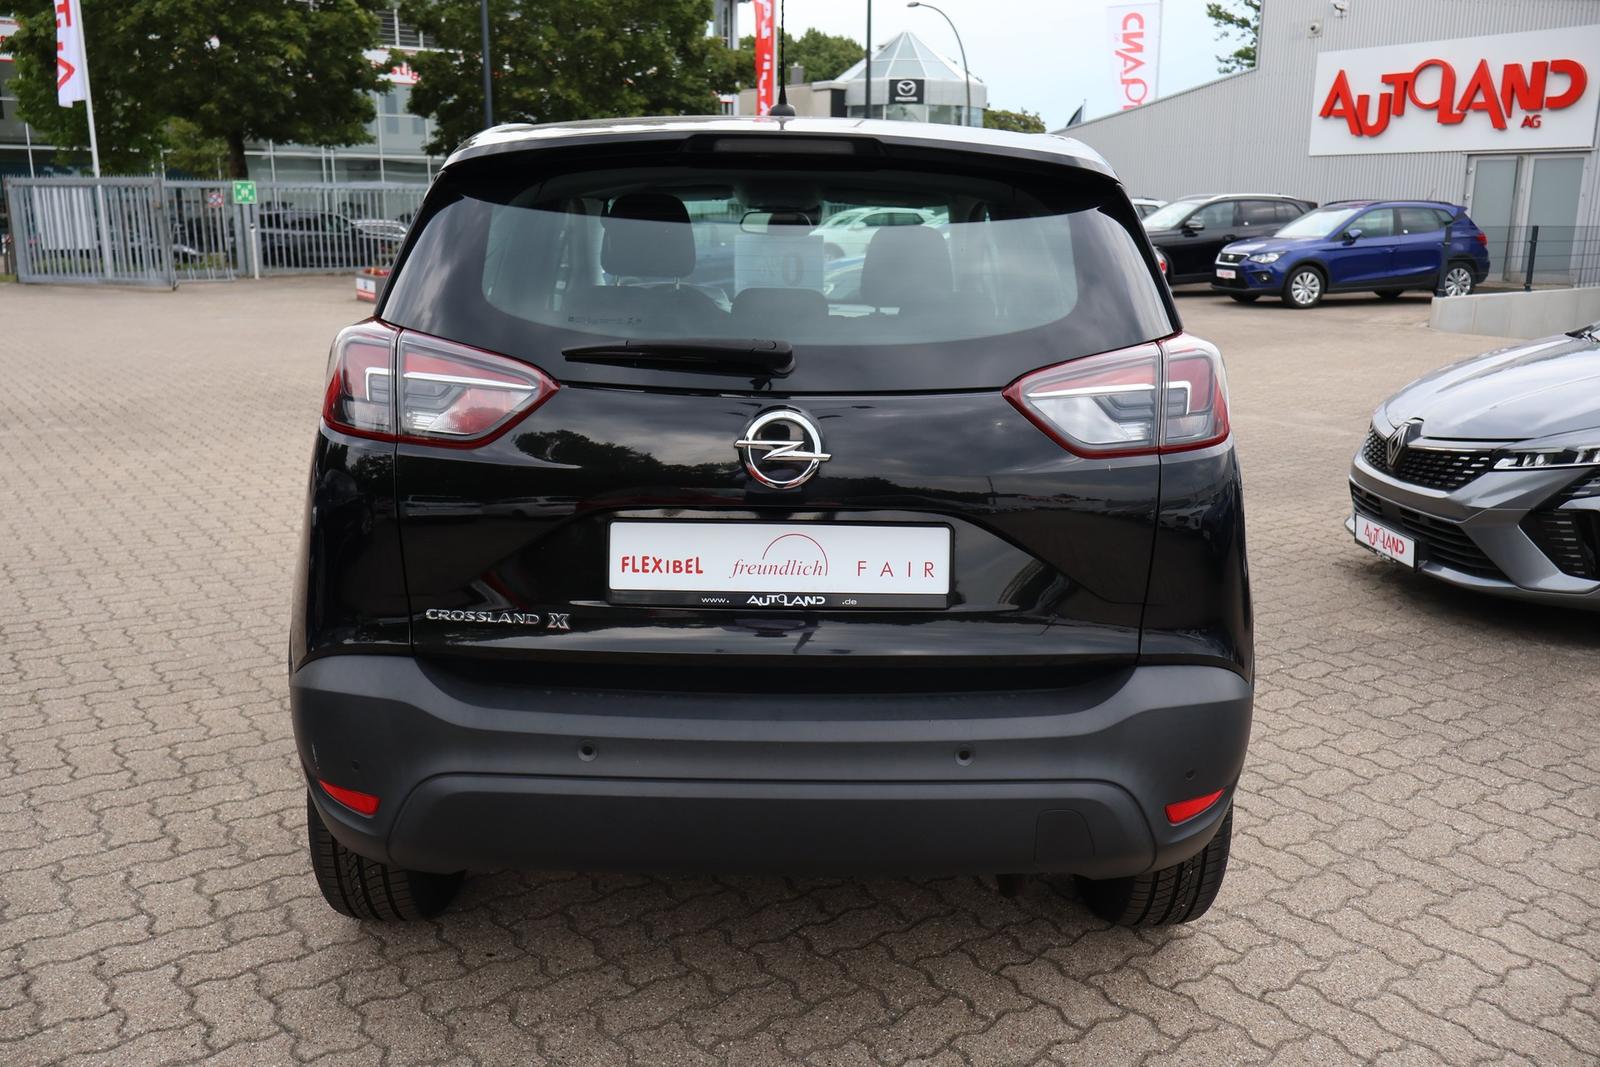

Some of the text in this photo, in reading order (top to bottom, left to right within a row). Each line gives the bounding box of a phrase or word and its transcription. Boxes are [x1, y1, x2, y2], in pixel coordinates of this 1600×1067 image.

[1319, 58, 1587, 137] AUTOLAND
[1521, 114, 1542, 129] AG
[1364, 522, 1405, 555] AUTOLAND
[729, 558, 825, 579] freundlich
[746, 593, 826, 607] AUTOLAND
[425, 608, 571, 630] CROSSLAND X
